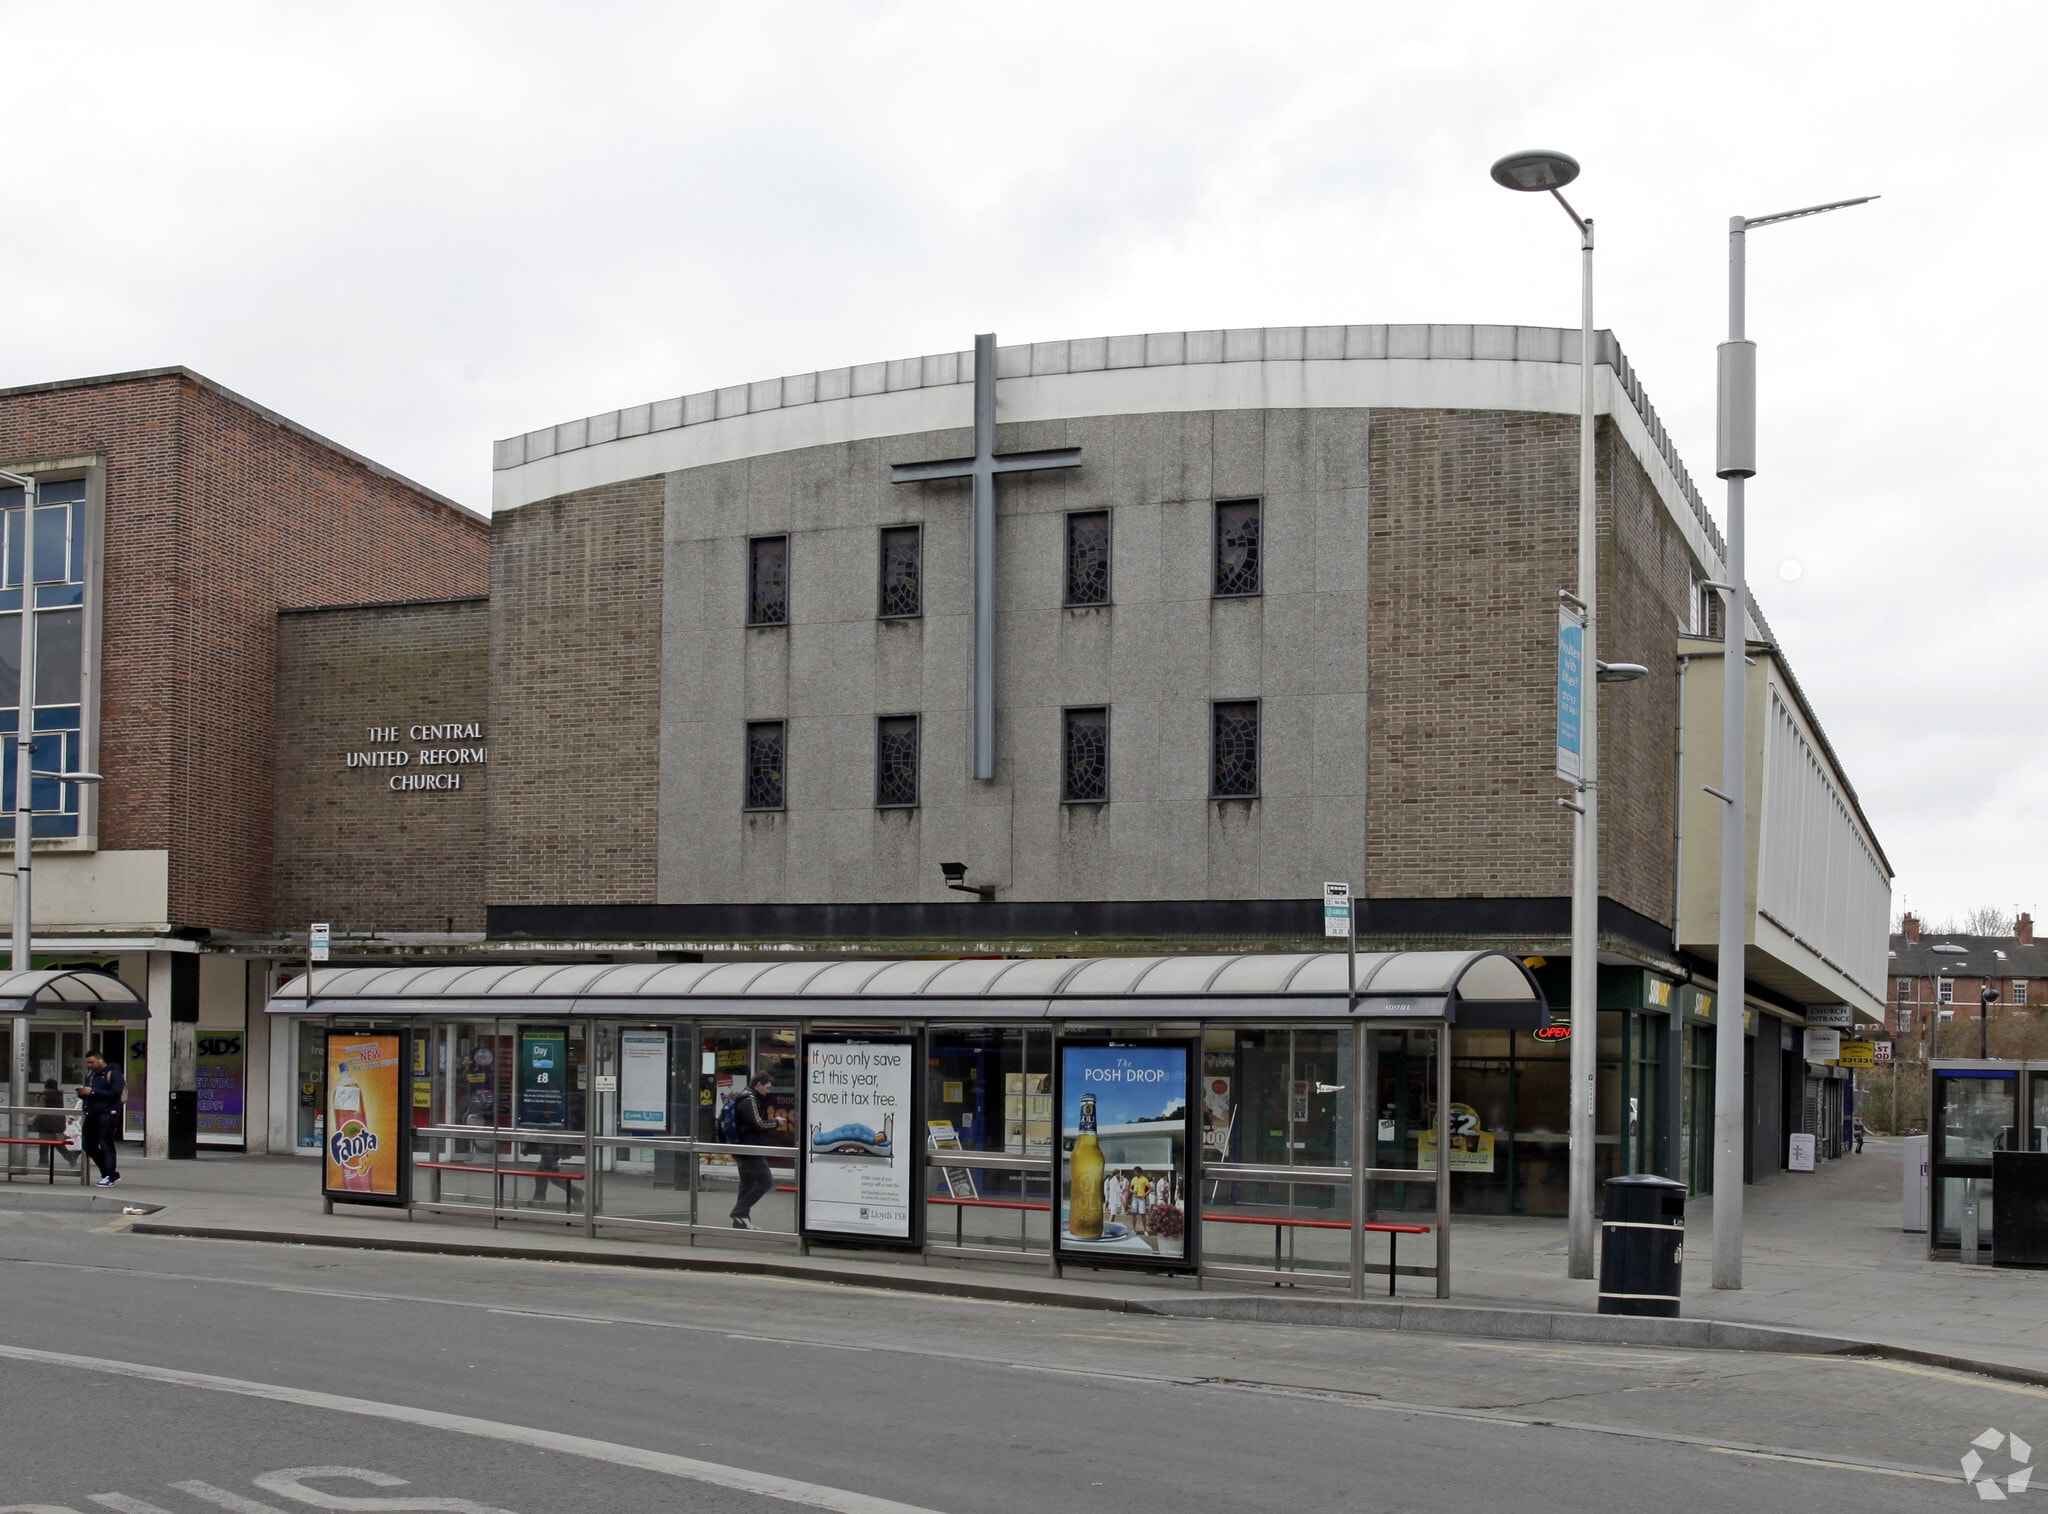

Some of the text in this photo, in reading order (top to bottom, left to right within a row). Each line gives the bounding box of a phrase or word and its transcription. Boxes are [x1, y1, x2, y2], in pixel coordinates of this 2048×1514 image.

[367, 723, 483, 742] THE CENTRAL
[347, 747, 487, 767] UNITED REFORM
[389, 773, 460, 790] CHURCH
[1808, 1015, 1850, 1023] ENTRANCE
[1538, 1027, 1571, 1038] OPEN
[360, 1048, 382, 1061] NEW
[534, 1046, 548, 1057] Day
[812, 1049, 901, 1069] If you only save
[1116, 1058, 1132, 1068] The
[537, 1072, 549, 1084] £8
[812, 1070, 879, 1088] £1 this year,
[1085, 1068, 1165, 1083] POSH DROP
[812, 1090, 898, 1107] save it tax free.
[329, 1128, 377, 1166] Fanta
[870, 1210, 907, 1221] Lloyds TSB
